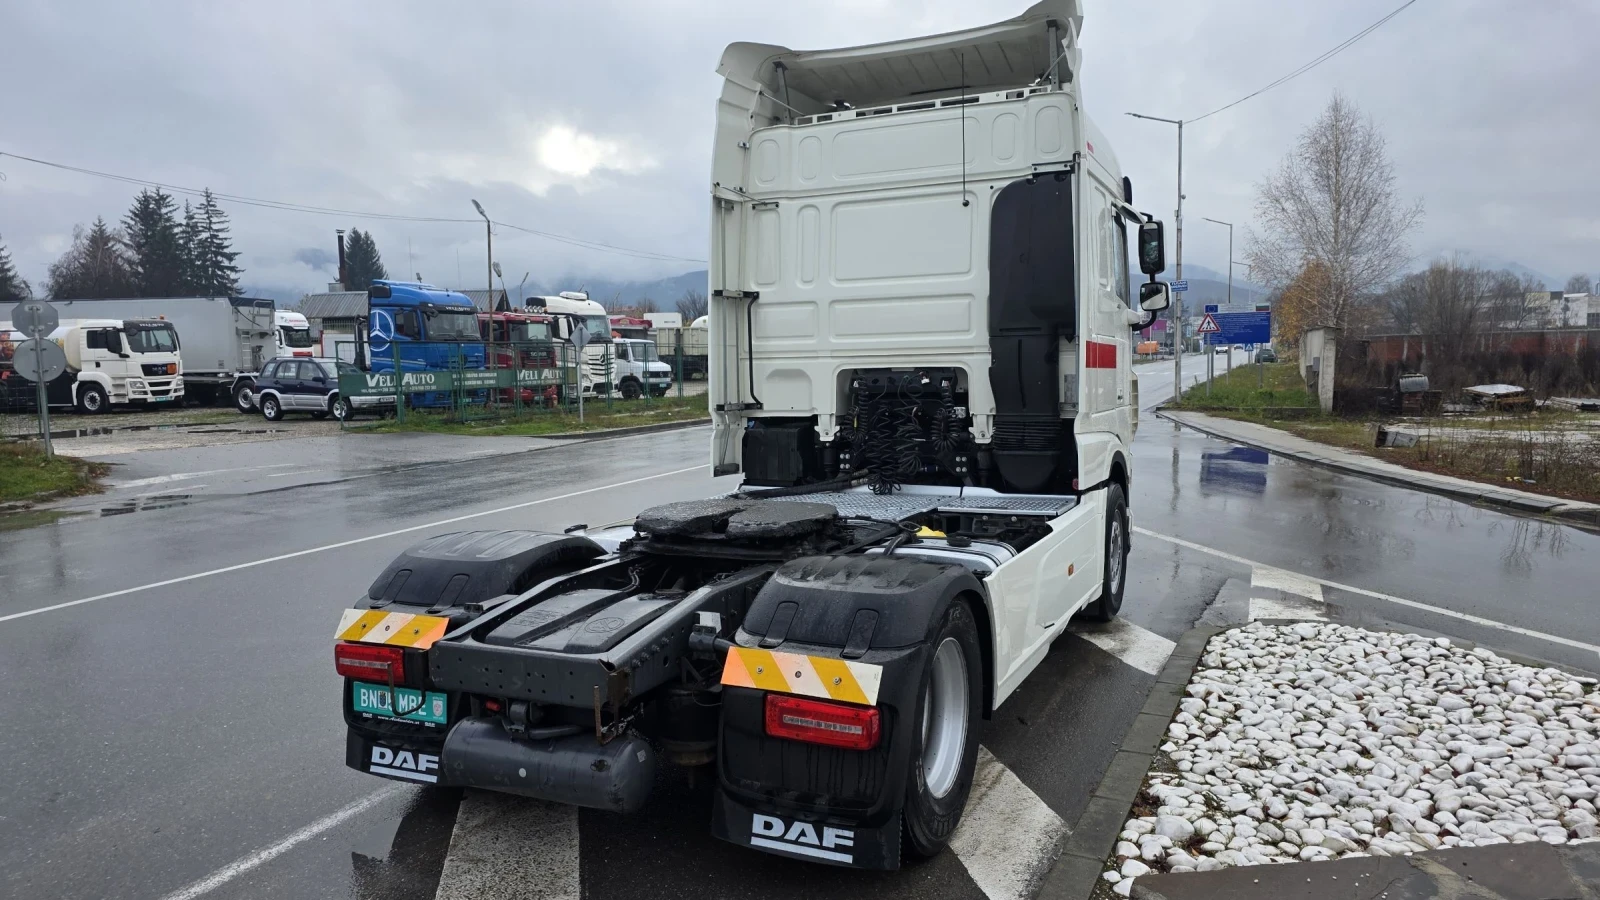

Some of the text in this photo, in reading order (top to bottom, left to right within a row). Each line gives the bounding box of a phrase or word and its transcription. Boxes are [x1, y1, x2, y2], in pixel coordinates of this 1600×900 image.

[402, 372, 435, 385] AUTO
[360, 688, 378, 709] BN
[371, 746, 439, 771] DAF
[752, 813, 855, 848] DAF
